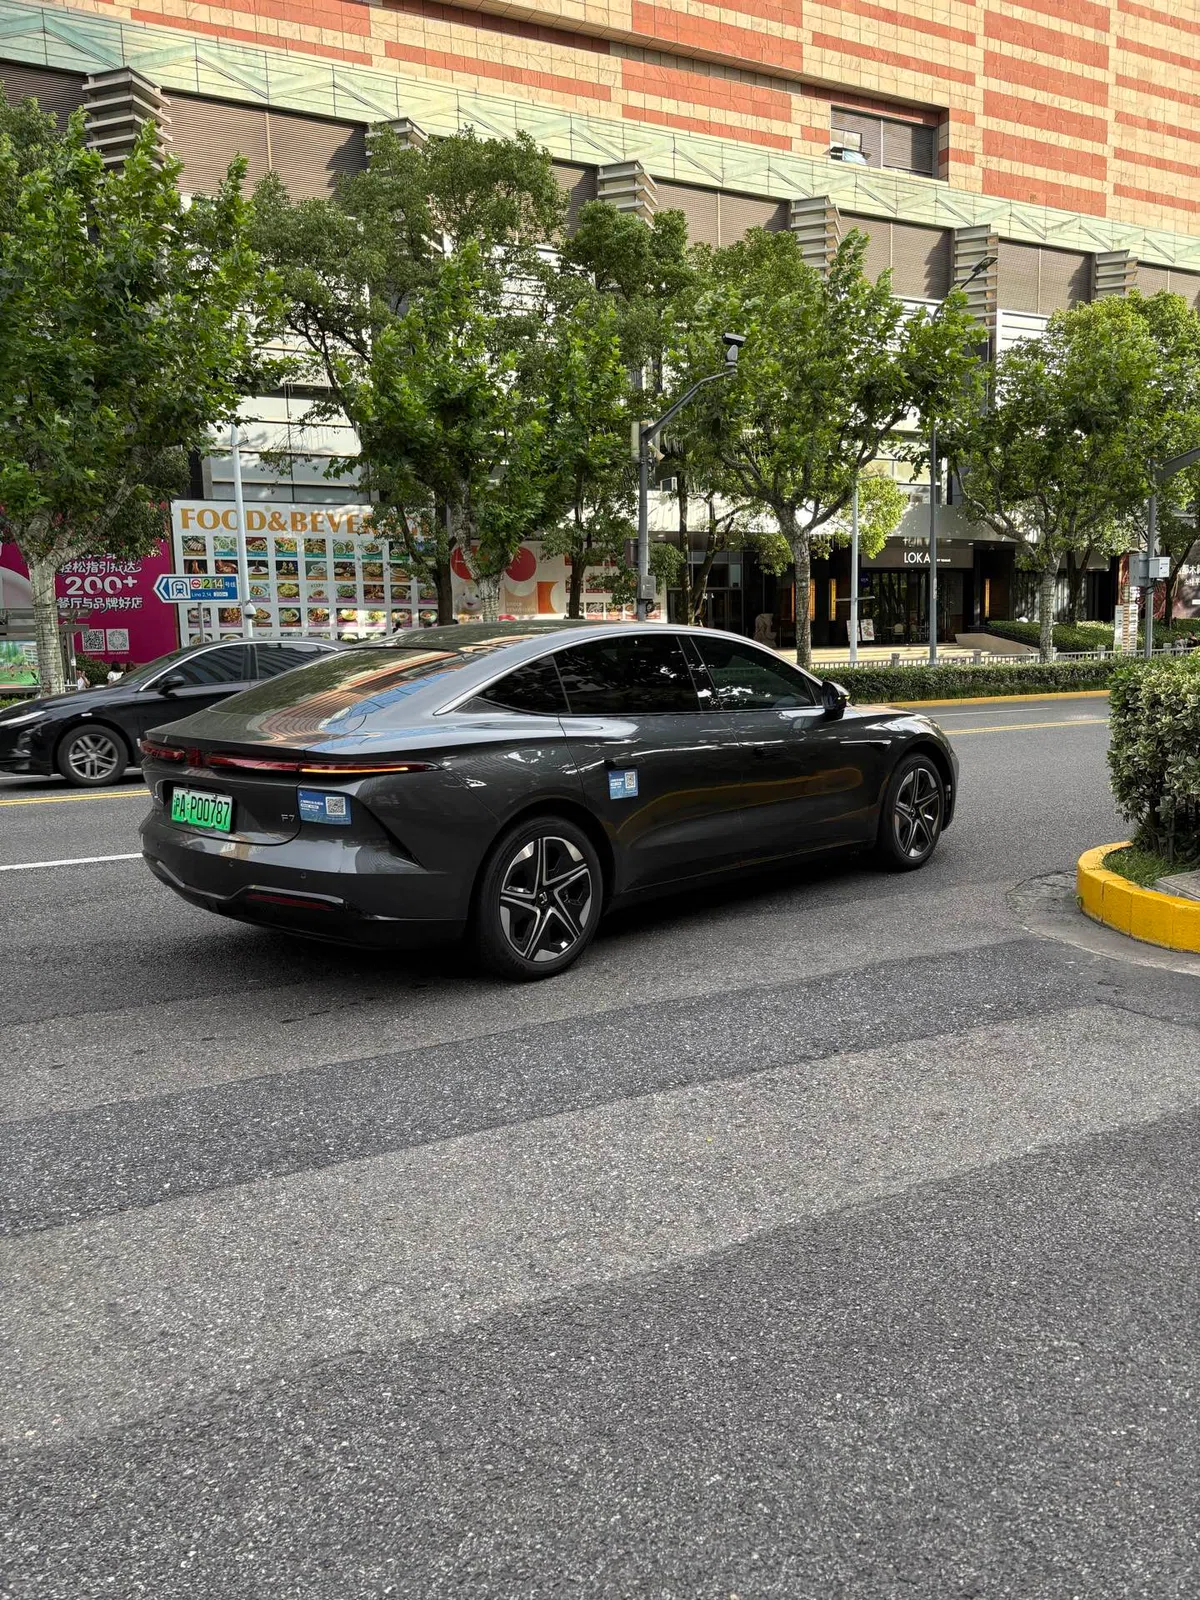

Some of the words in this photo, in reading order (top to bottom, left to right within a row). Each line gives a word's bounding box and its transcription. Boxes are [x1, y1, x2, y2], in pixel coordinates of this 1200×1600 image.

[904, 552, 932, 563] LOKA
[65, 576, 138, 595] 200+
[57, 597, 142, 613] 餐厅与品牌好店
